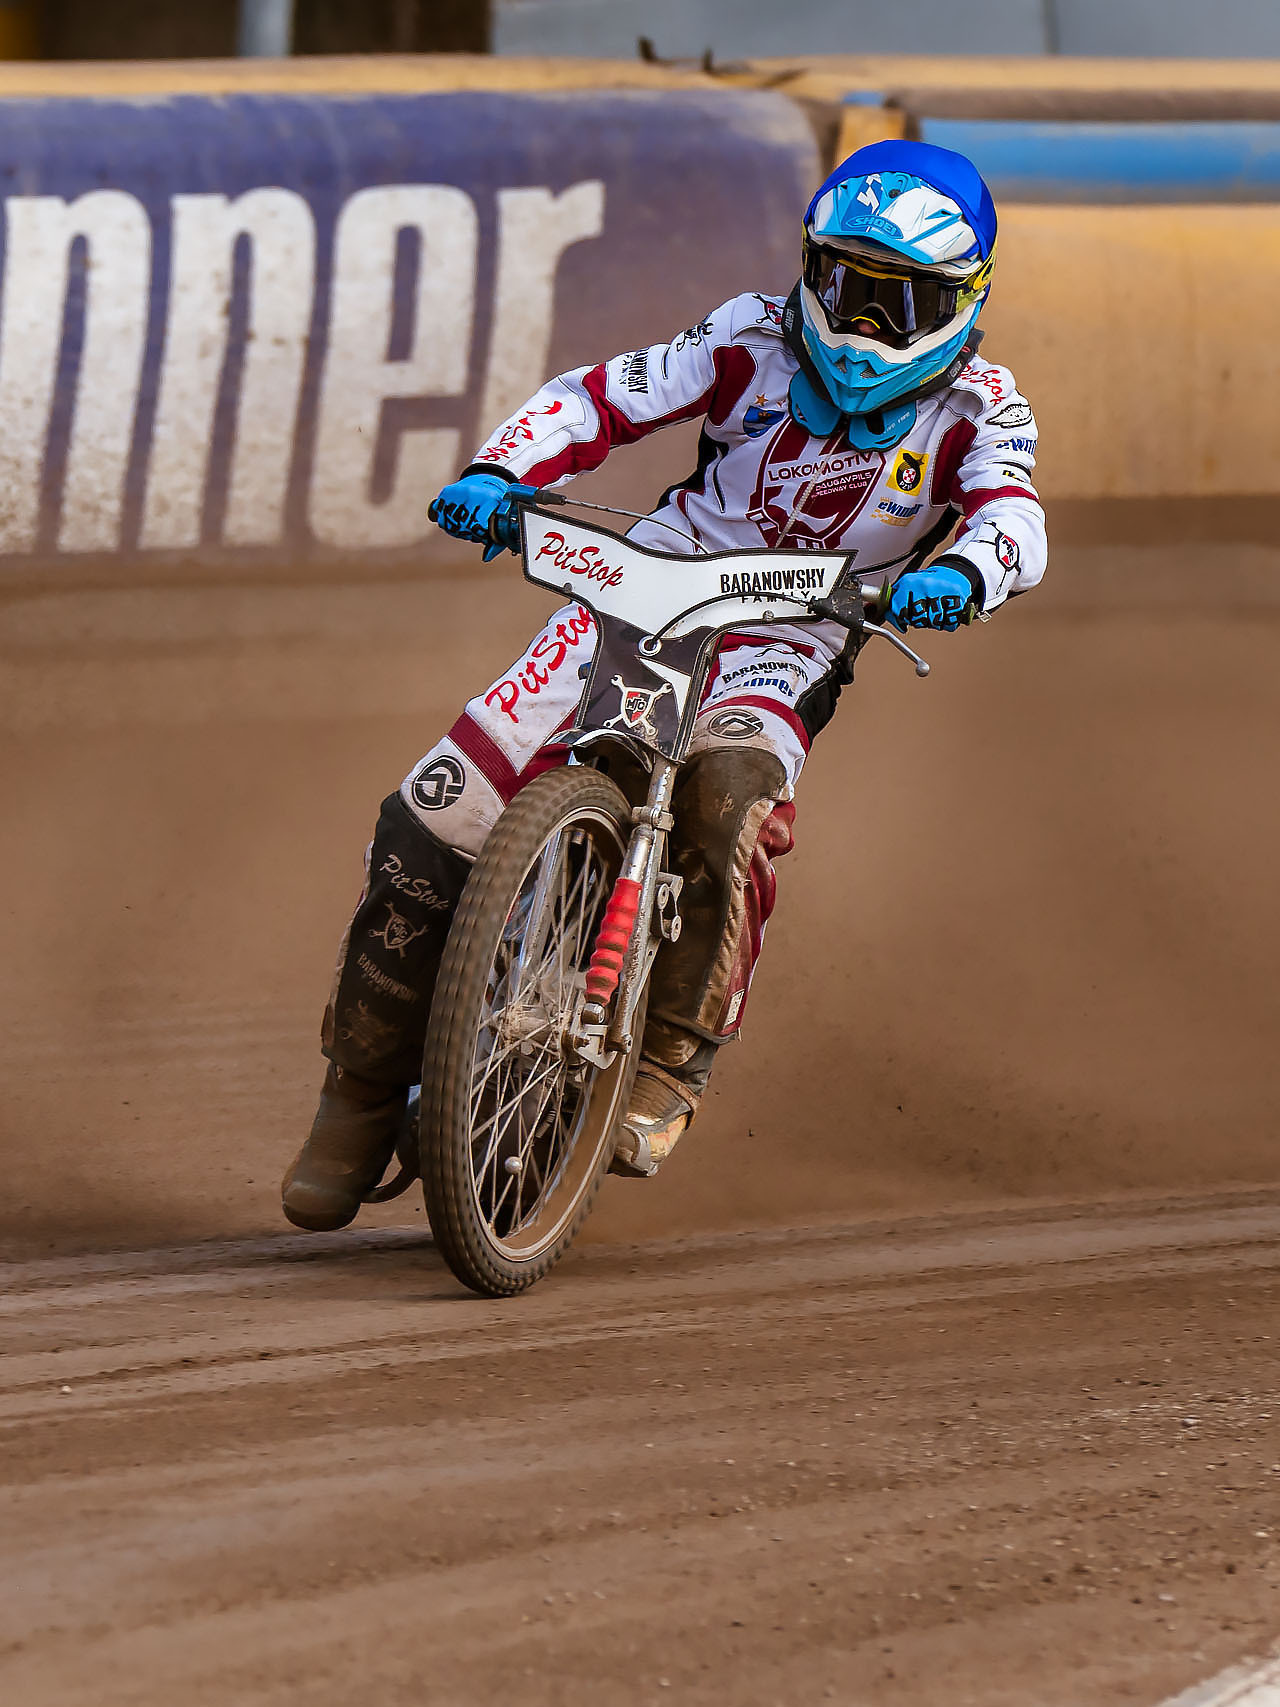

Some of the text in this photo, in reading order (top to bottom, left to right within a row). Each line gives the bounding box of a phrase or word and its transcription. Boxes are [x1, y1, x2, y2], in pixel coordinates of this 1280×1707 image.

[853, 215, 899, 235] SHOEI
[768, 452, 873, 481] LOKOMOTIV
[535, 531, 624, 592] PitStop
[720, 567, 826, 593] BARANOWSKY
